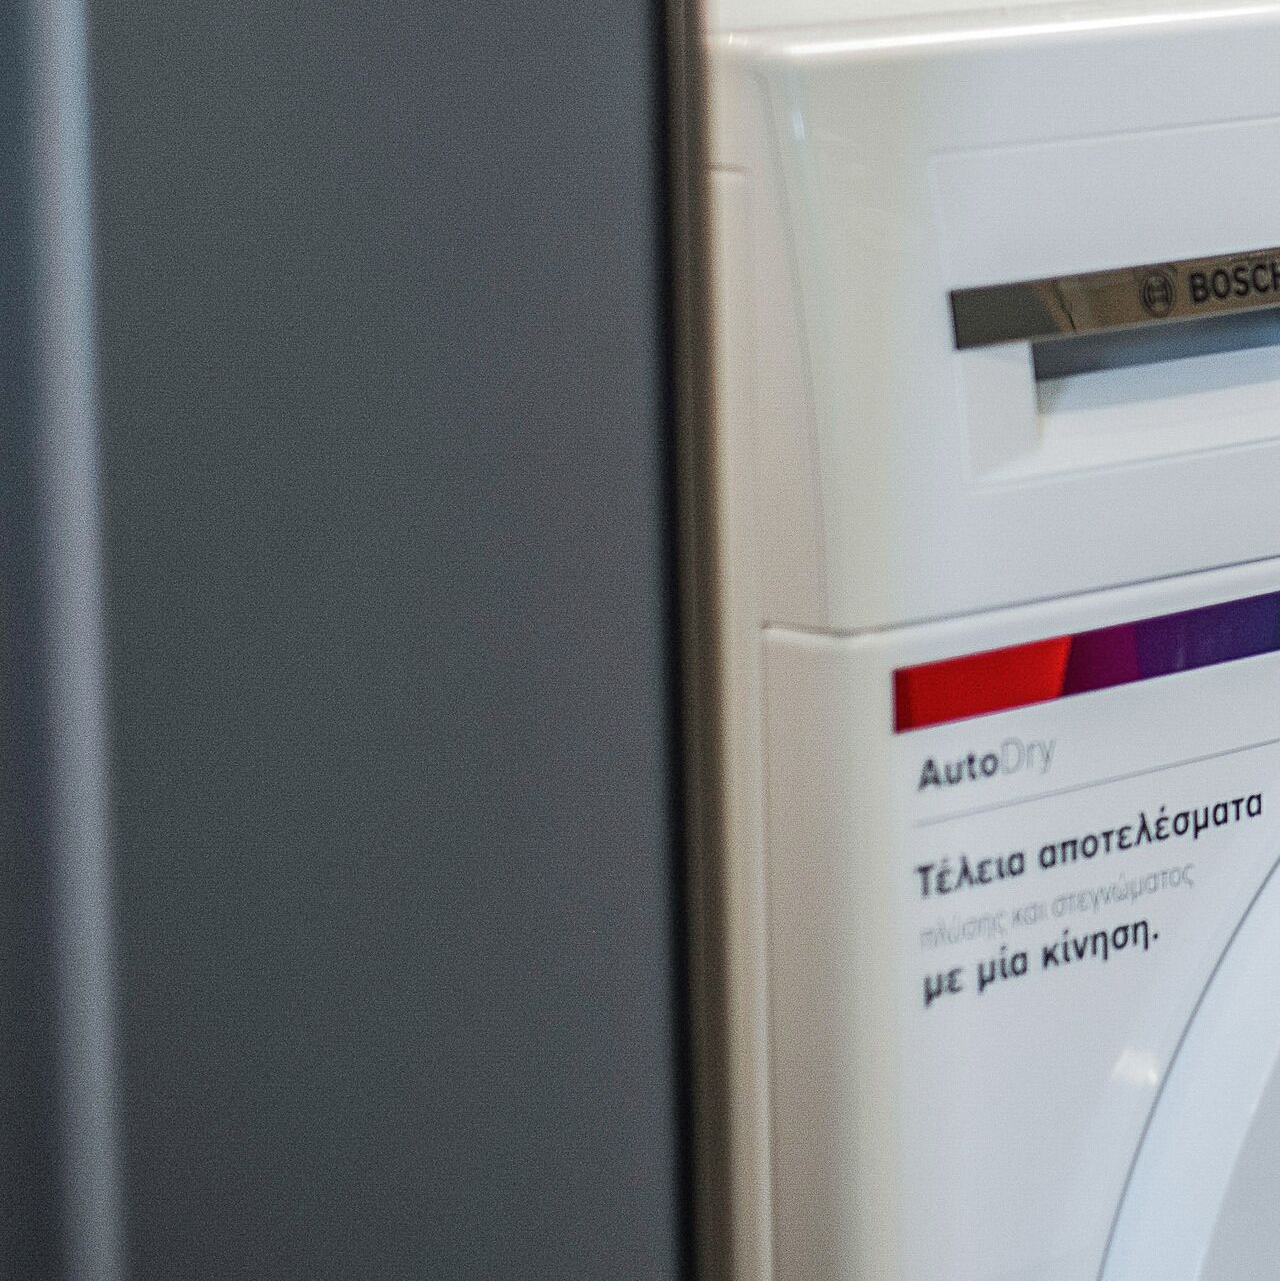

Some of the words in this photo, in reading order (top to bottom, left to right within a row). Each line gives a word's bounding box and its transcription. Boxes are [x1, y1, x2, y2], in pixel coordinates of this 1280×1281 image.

[917, 736, 1057, 792] AutoDry
[915, 846, 1026, 901] Τέλεια
[1038, 790, 1263, 871] αποτελέσματα
[923, 966, 963, 1006] με
[976, 946, 1028, 994] μία
[1041, 919, 1159, 969] κίνηση.
